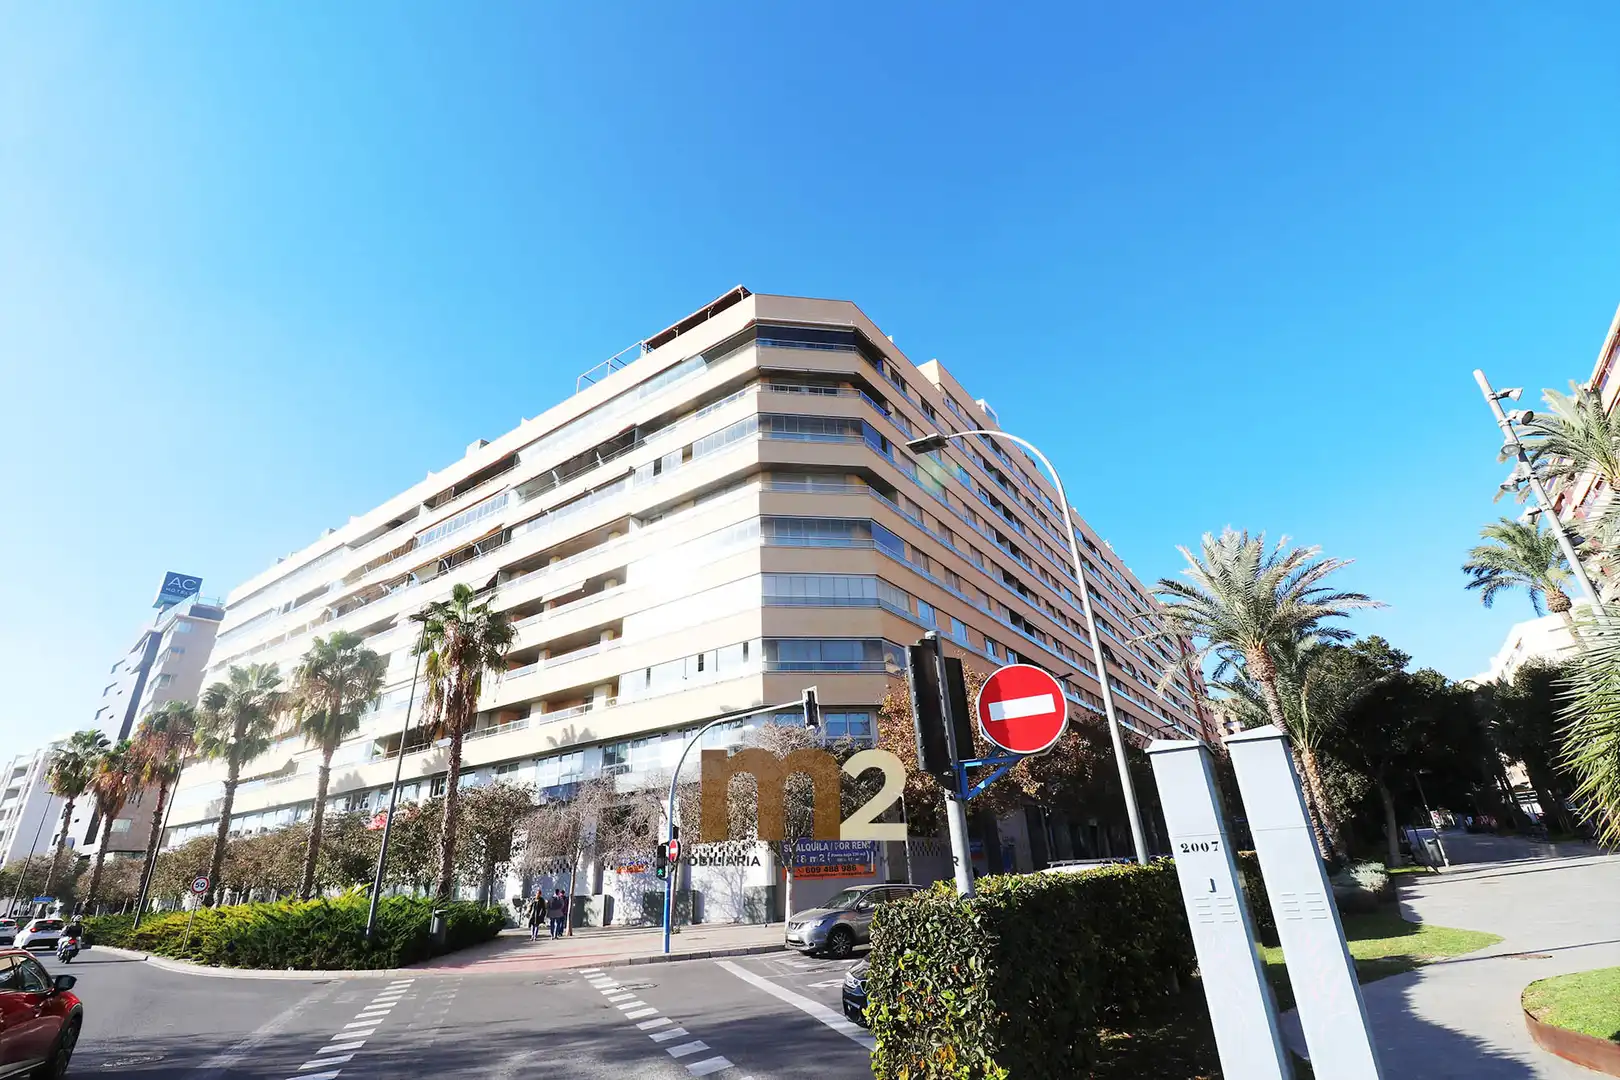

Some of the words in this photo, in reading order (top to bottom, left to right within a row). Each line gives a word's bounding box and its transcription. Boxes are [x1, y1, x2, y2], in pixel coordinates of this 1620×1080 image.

[168, 577, 196, 590] AC
[796, 842, 830, 853] ALQUILA
[1180, 841, 1219, 853] 2007
